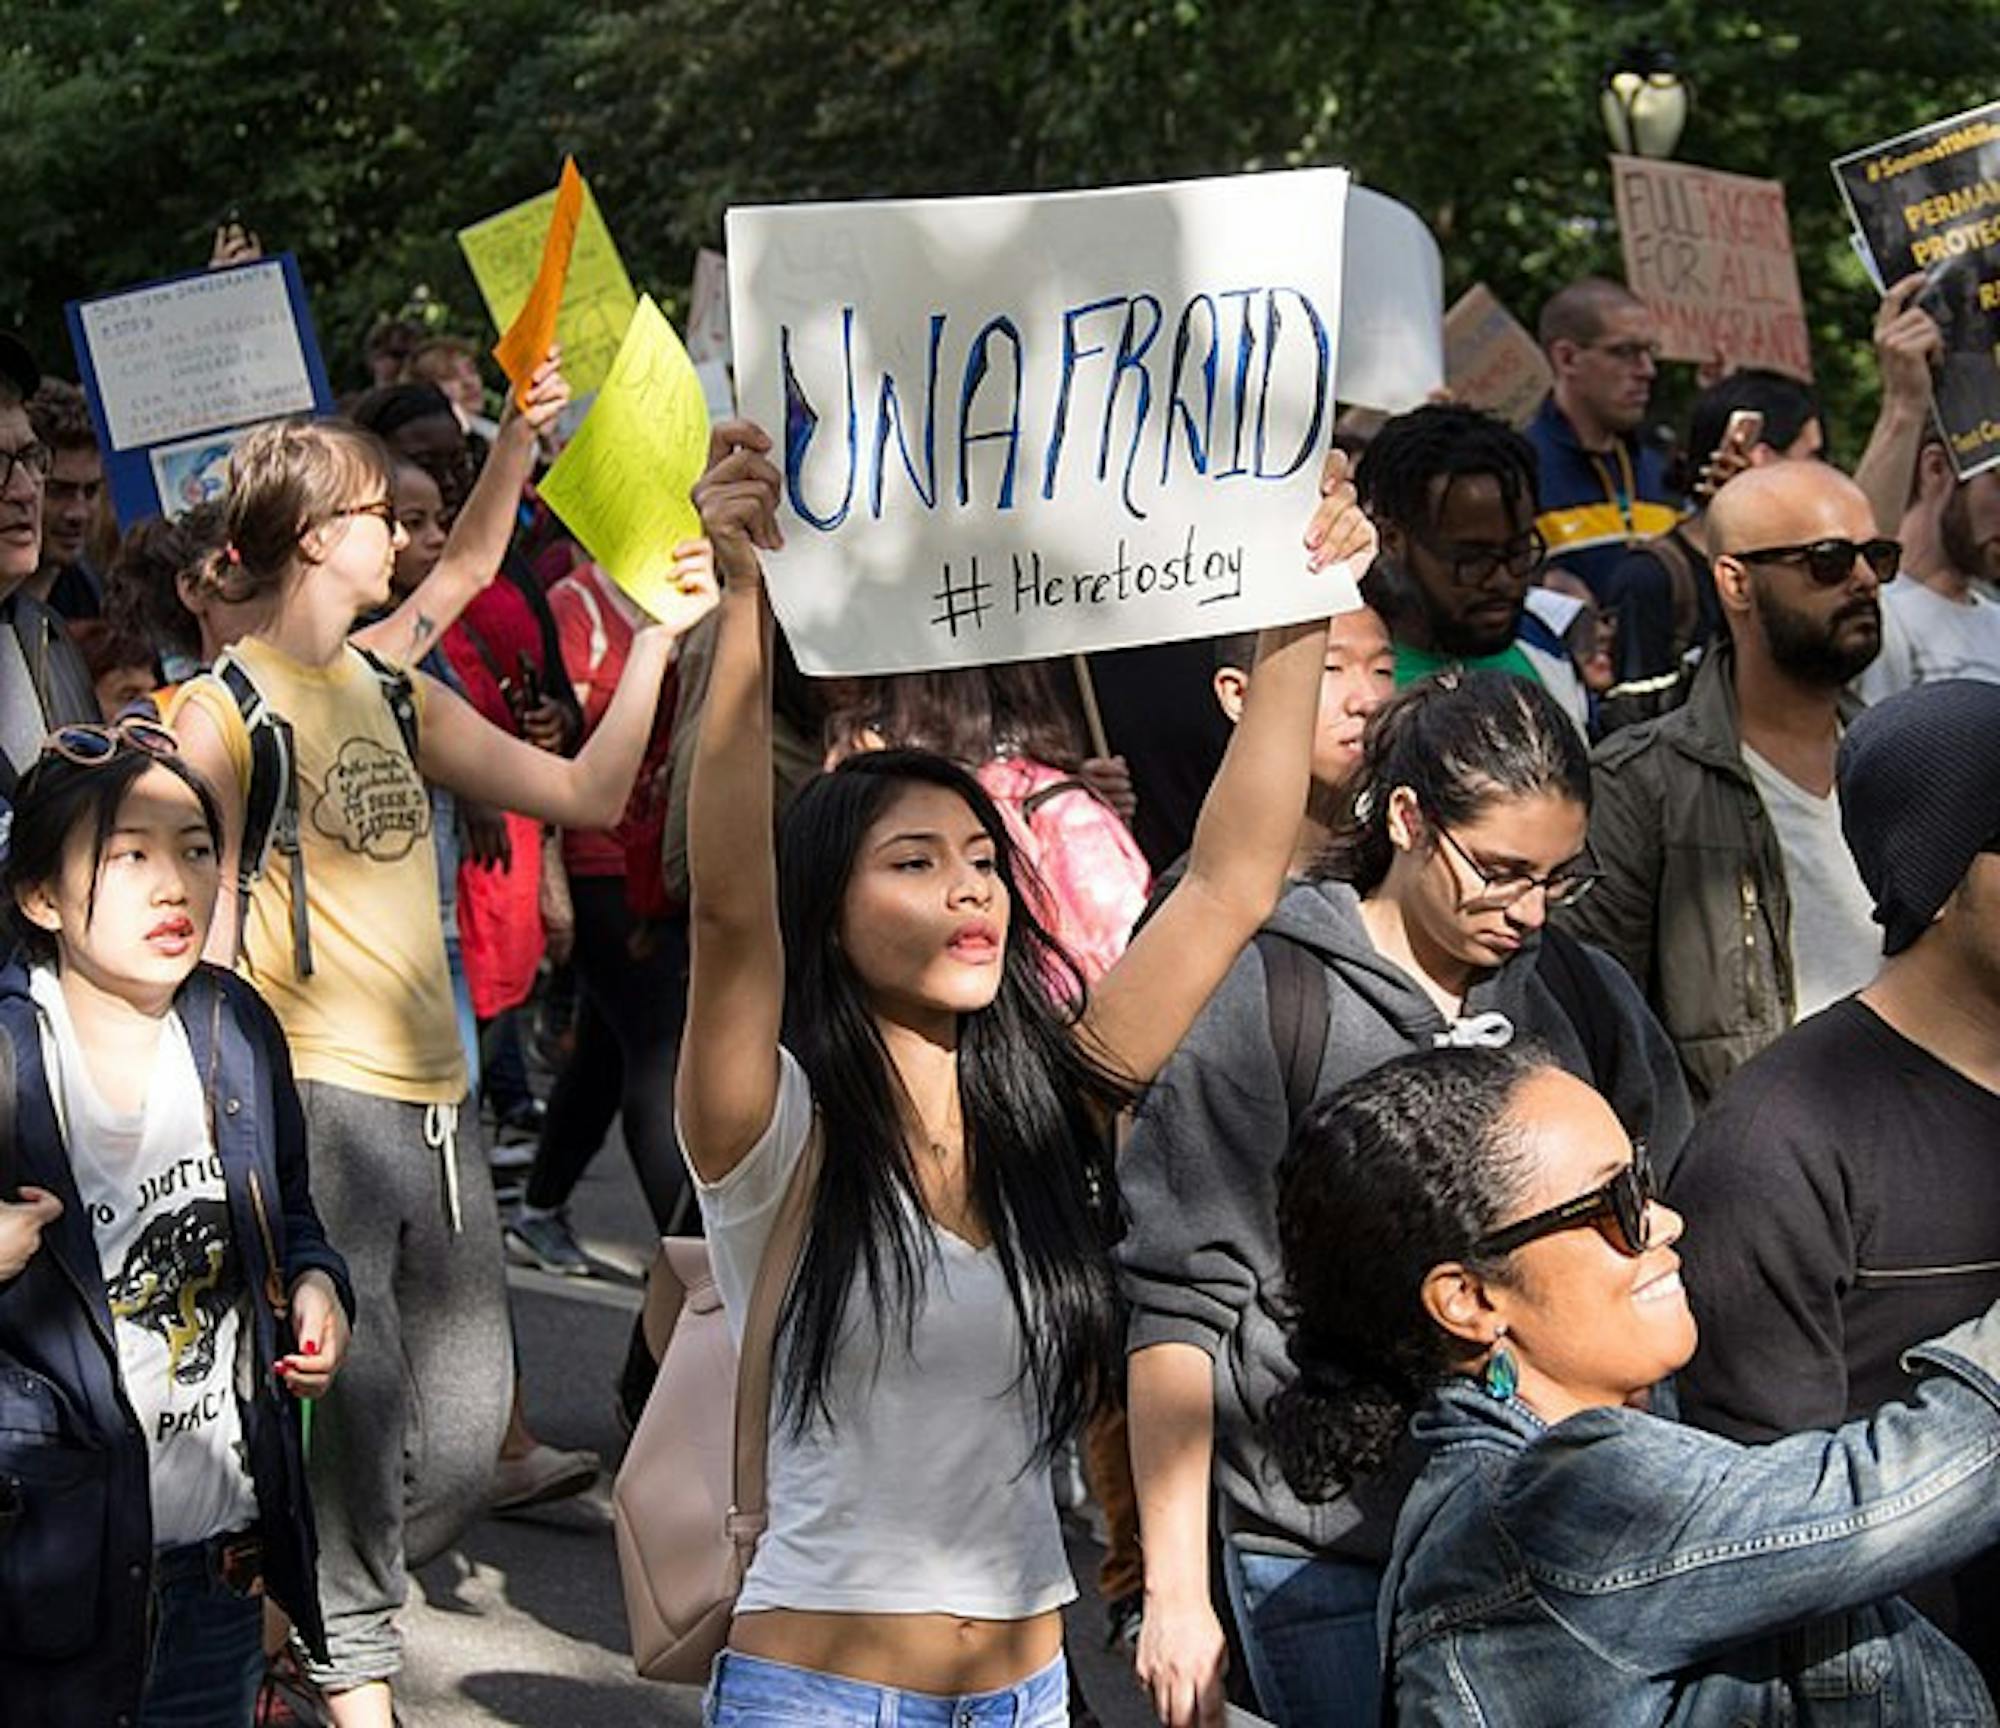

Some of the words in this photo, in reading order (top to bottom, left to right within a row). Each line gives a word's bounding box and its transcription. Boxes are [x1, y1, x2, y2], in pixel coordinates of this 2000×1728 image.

[1624, 171, 1703, 240] FULL
[1634, 233, 1712, 297] FOR
[1716, 253, 1788, 305] ALL
[781, 285, 1331, 532] UNAFRAID
[137, 1153, 226, 1213] JUSTIC
[157, 1386, 227, 1443] PEAC
